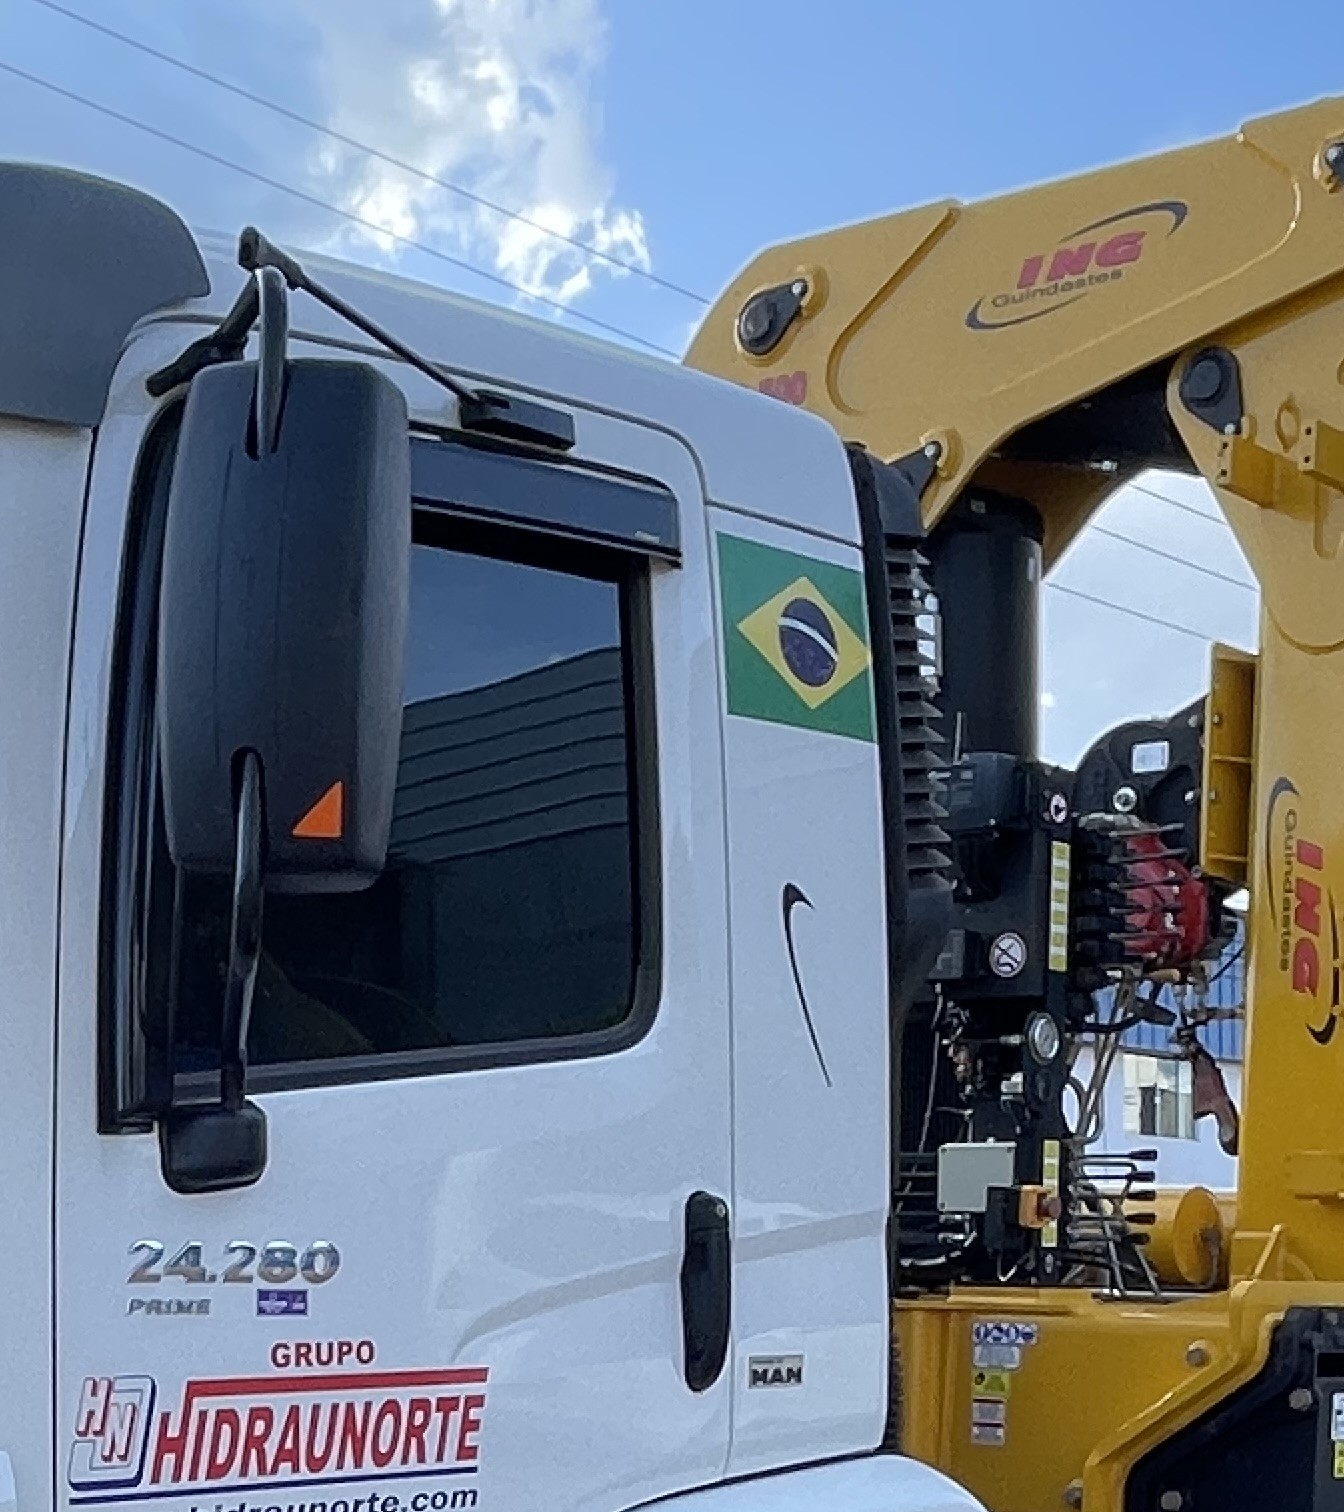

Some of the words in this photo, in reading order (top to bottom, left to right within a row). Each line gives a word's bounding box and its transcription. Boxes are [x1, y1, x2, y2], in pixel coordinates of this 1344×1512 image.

[1016, 231, 1146, 289] ING
[1292, 838, 1324, 997] ING
[126, 1239, 341, 1284] 24.280
[270, 1340, 376, 1368] GRUPO
[752, 1366, 802, 1386] MAN
[150, 1381, 486, 1486] HIDRAUNORTE
